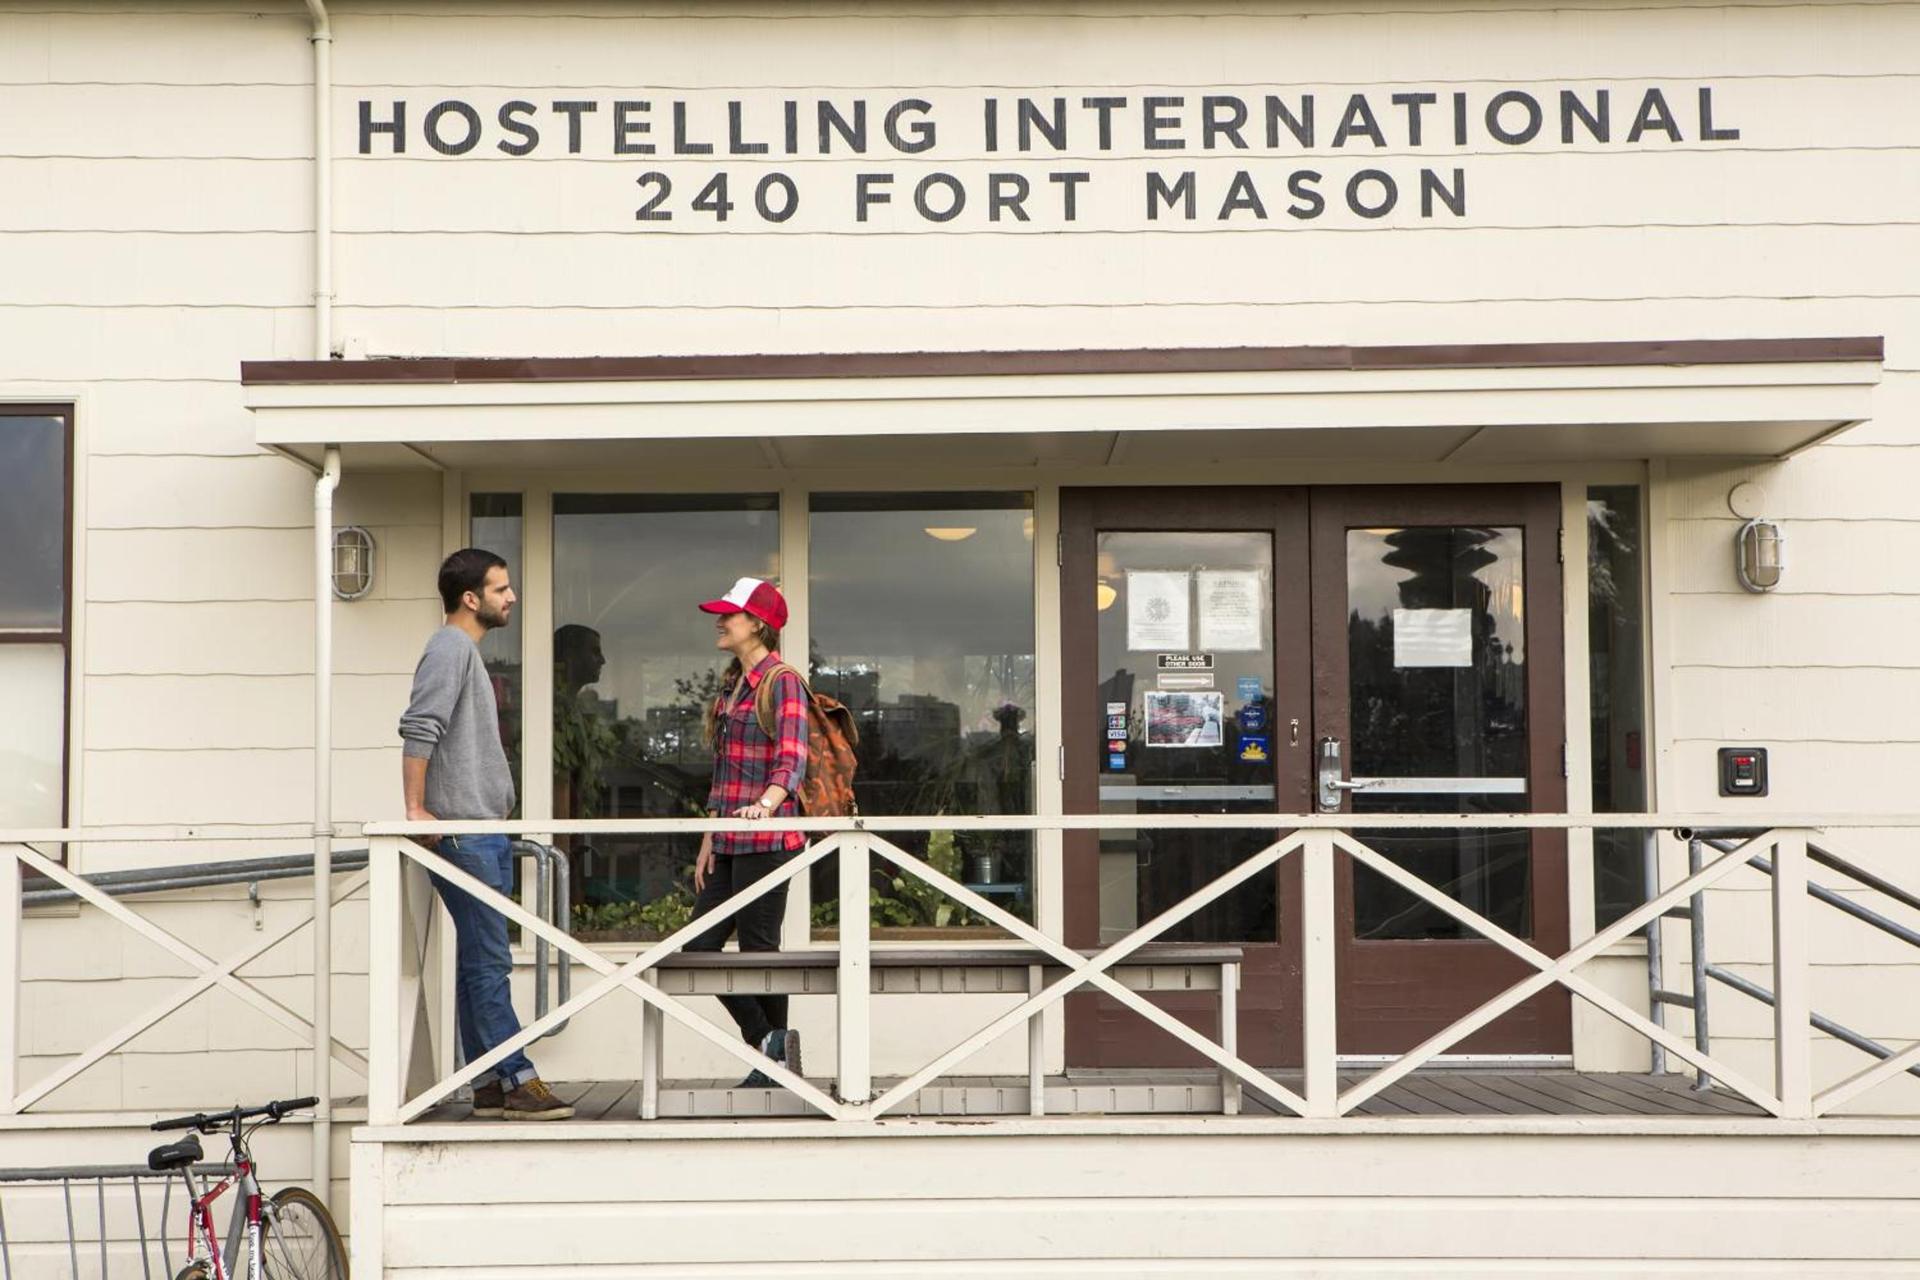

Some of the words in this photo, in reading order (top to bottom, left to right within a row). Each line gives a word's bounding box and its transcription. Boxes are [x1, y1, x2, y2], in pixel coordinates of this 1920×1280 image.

[358, 99, 936, 156] HOSTELLING
[984, 87, 1740, 152] INTERNATIONAL
[636, 172, 799, 222] 240
[856, 172, 1090, 222] FORT
[1146, 168, 1465, 220] MASON
